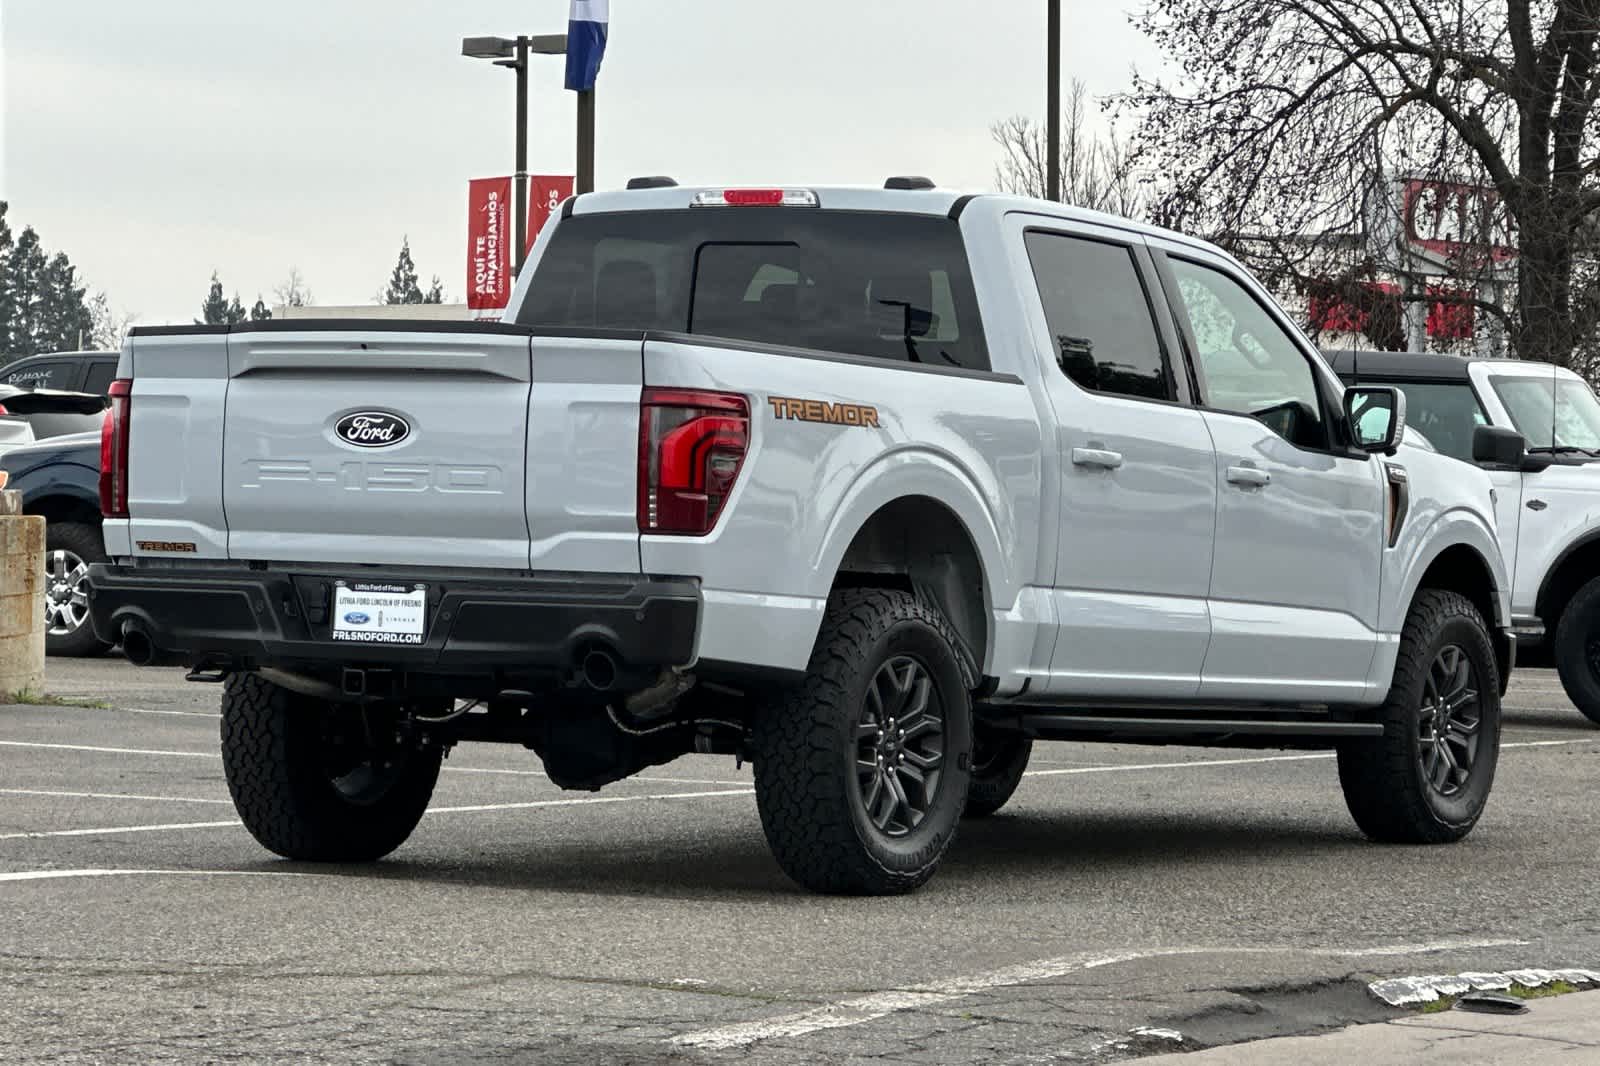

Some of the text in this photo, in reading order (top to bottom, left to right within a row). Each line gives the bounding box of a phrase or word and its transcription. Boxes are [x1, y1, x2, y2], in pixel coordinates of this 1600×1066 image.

[474, 236, 487, 294] AQUÍ TE
[768, 396, 881, 428] TREMOR
[347, 416, 396, 441] Ford
[241, 458, 504, 495] F-150
[136, 540, 197, 553] TREMOR
